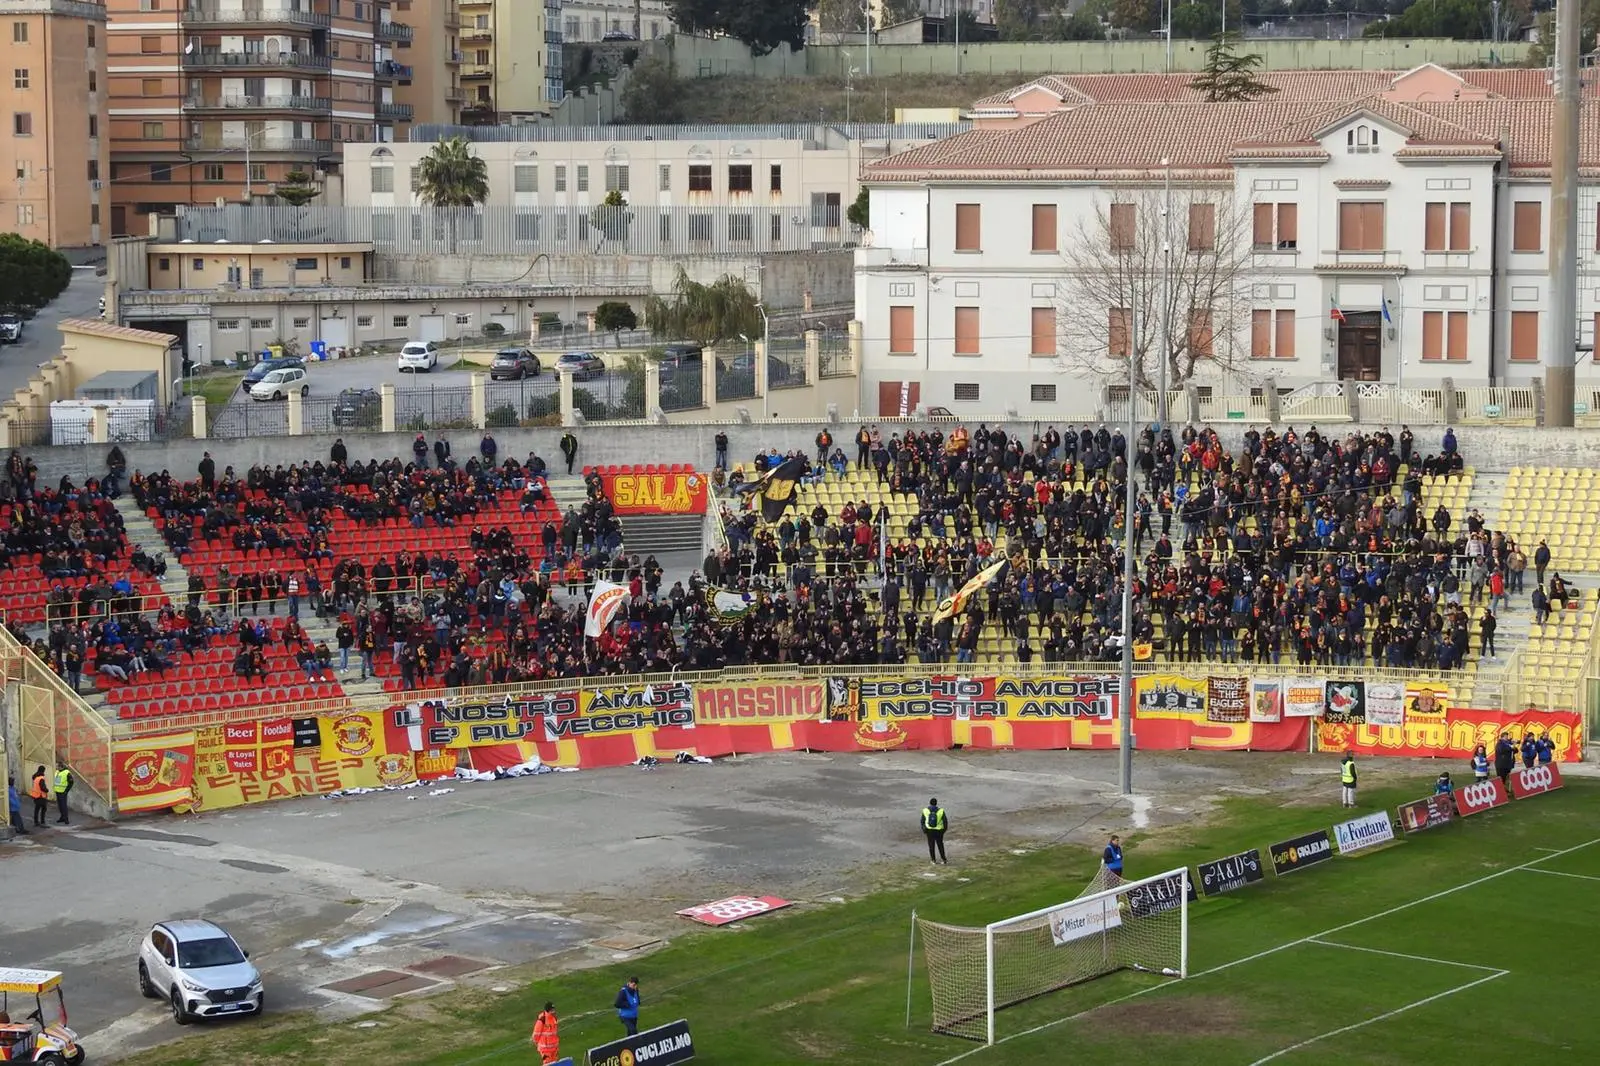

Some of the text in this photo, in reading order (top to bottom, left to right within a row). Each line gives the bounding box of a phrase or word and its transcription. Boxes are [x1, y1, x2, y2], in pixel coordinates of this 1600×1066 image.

[614, 475, 692, 507] SALA
[862, 680, 1132, 697] ECCHIO AMORE
[1213, 679, 1242, 689] BESIDE
[696, 684, 824, 720] MASSIMO
[1219, 690, 1238, 698] THE
[879, 700, 1008, 717] NOSTRI
[1018, 700, 1110, 717] ANNI
[1210, 698, 1245, 708] EAGLES
[394, 709, 423, 727] IL
[435, 698, 577, 723] NOSTRO
[227, 728, 255, 738] Beer
[264, 723, 292, 736] Football
[428, 708, 693, 744] E' PIU' VECCHIO
[236, 751, 255, 760] Loyal
[1520, 765, 1552, 791] coop
[240, 772, 342, 802] FANS
[1464, 780, 1497, 807] coop
[1347, 819, 1388, 841] Fontane
[1226, 863, 1235, 879] &
[1064, 917, 1086, 931] Mister
[634, 1032, 692, 1062] GUGLIELMO
